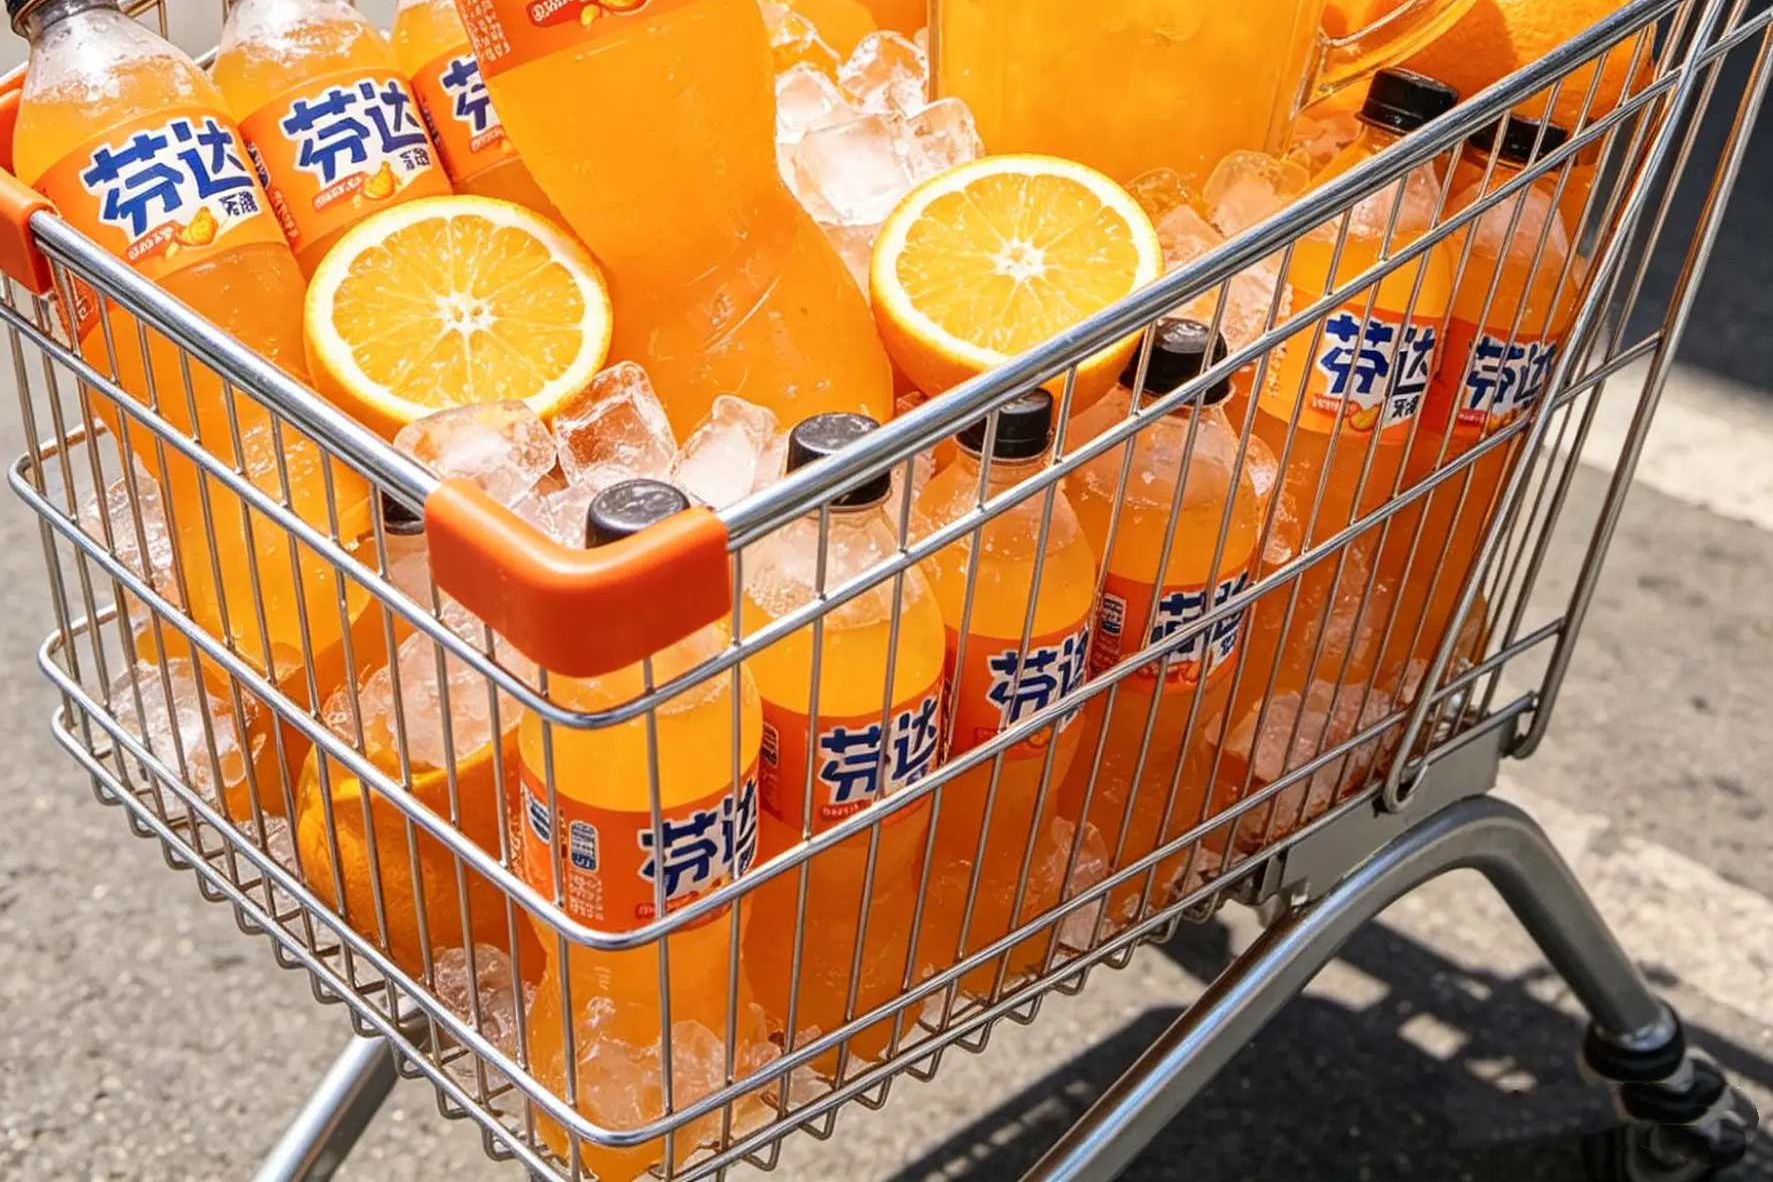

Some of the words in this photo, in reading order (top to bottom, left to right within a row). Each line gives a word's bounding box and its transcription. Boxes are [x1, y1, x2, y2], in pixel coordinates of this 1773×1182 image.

[84, 119, 255, 237] 芬达
[283, 82, 428, 183] 芬达
[1320, 314, 1435, 395] 芬达
[821, 699, 938, 802] 芬达
